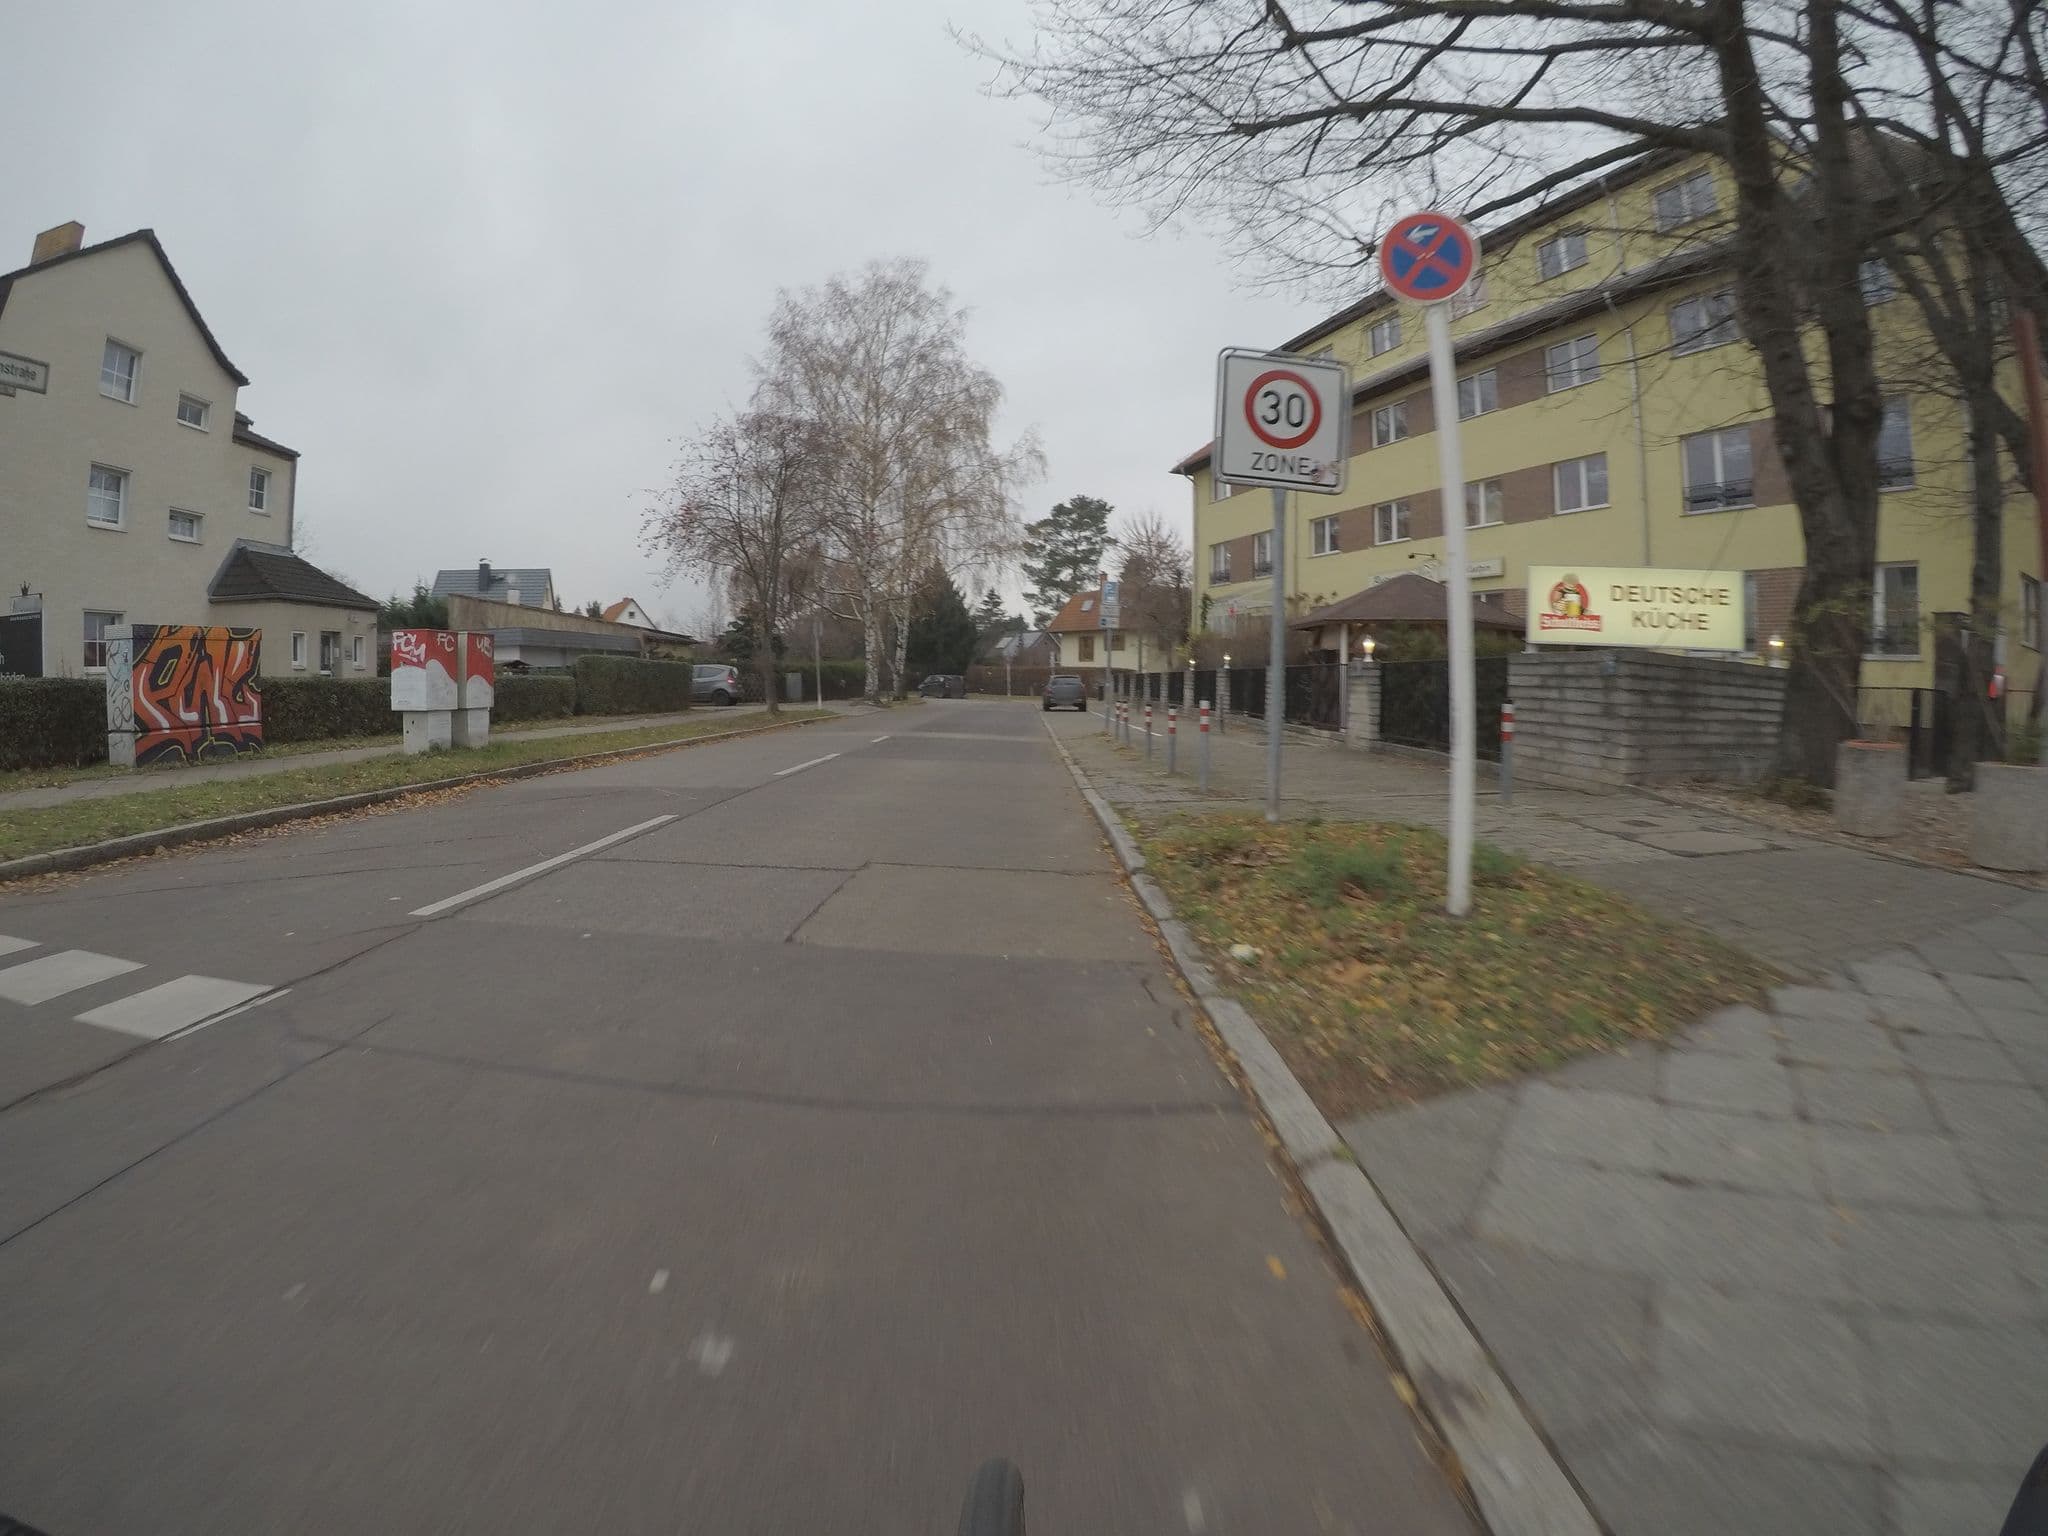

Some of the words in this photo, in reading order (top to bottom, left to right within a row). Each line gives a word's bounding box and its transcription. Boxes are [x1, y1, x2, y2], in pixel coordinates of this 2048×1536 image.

[1262, 390, 1305, 428] 30
[1251, 451, 1312, 476] ZONE
[1610, 585, 1731, 606] DEUTSCHE
[1632, 608, 1710, 630] KÜCHE
